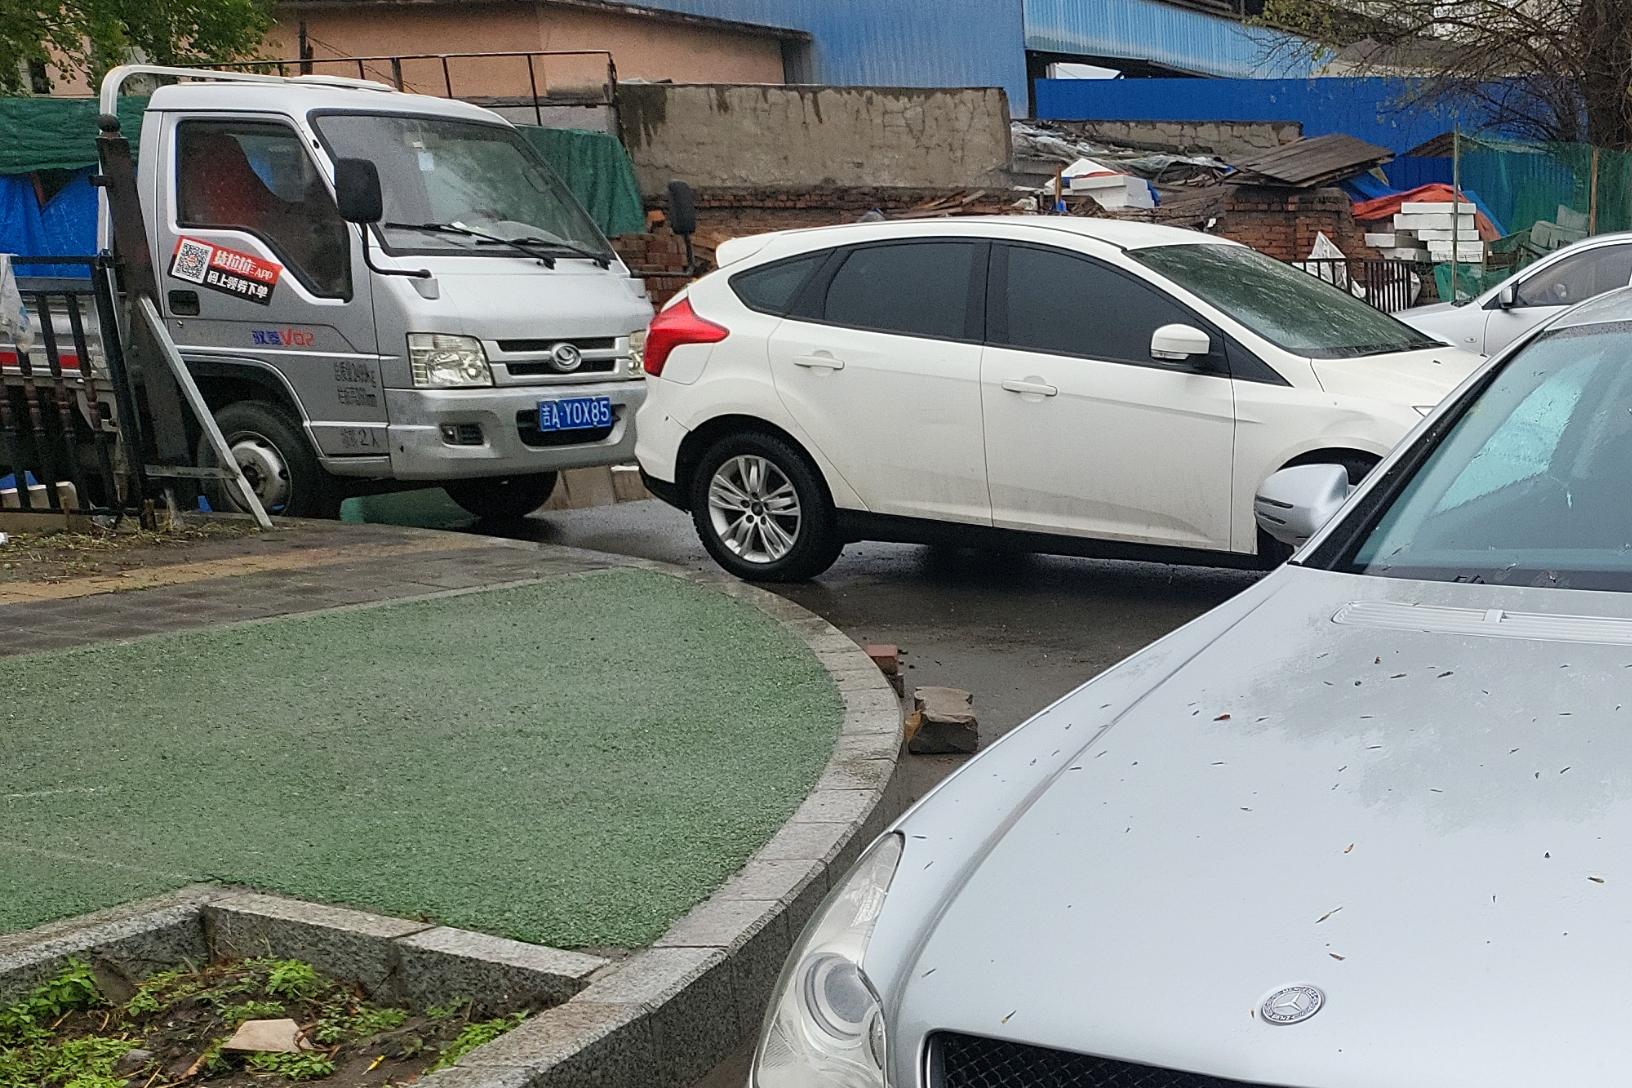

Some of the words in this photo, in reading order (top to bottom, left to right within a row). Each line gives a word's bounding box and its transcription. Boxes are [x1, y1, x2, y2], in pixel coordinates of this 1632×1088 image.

[254, 268, 273, 280] APP
[207, 270, 269, 299] 码上领券下单
